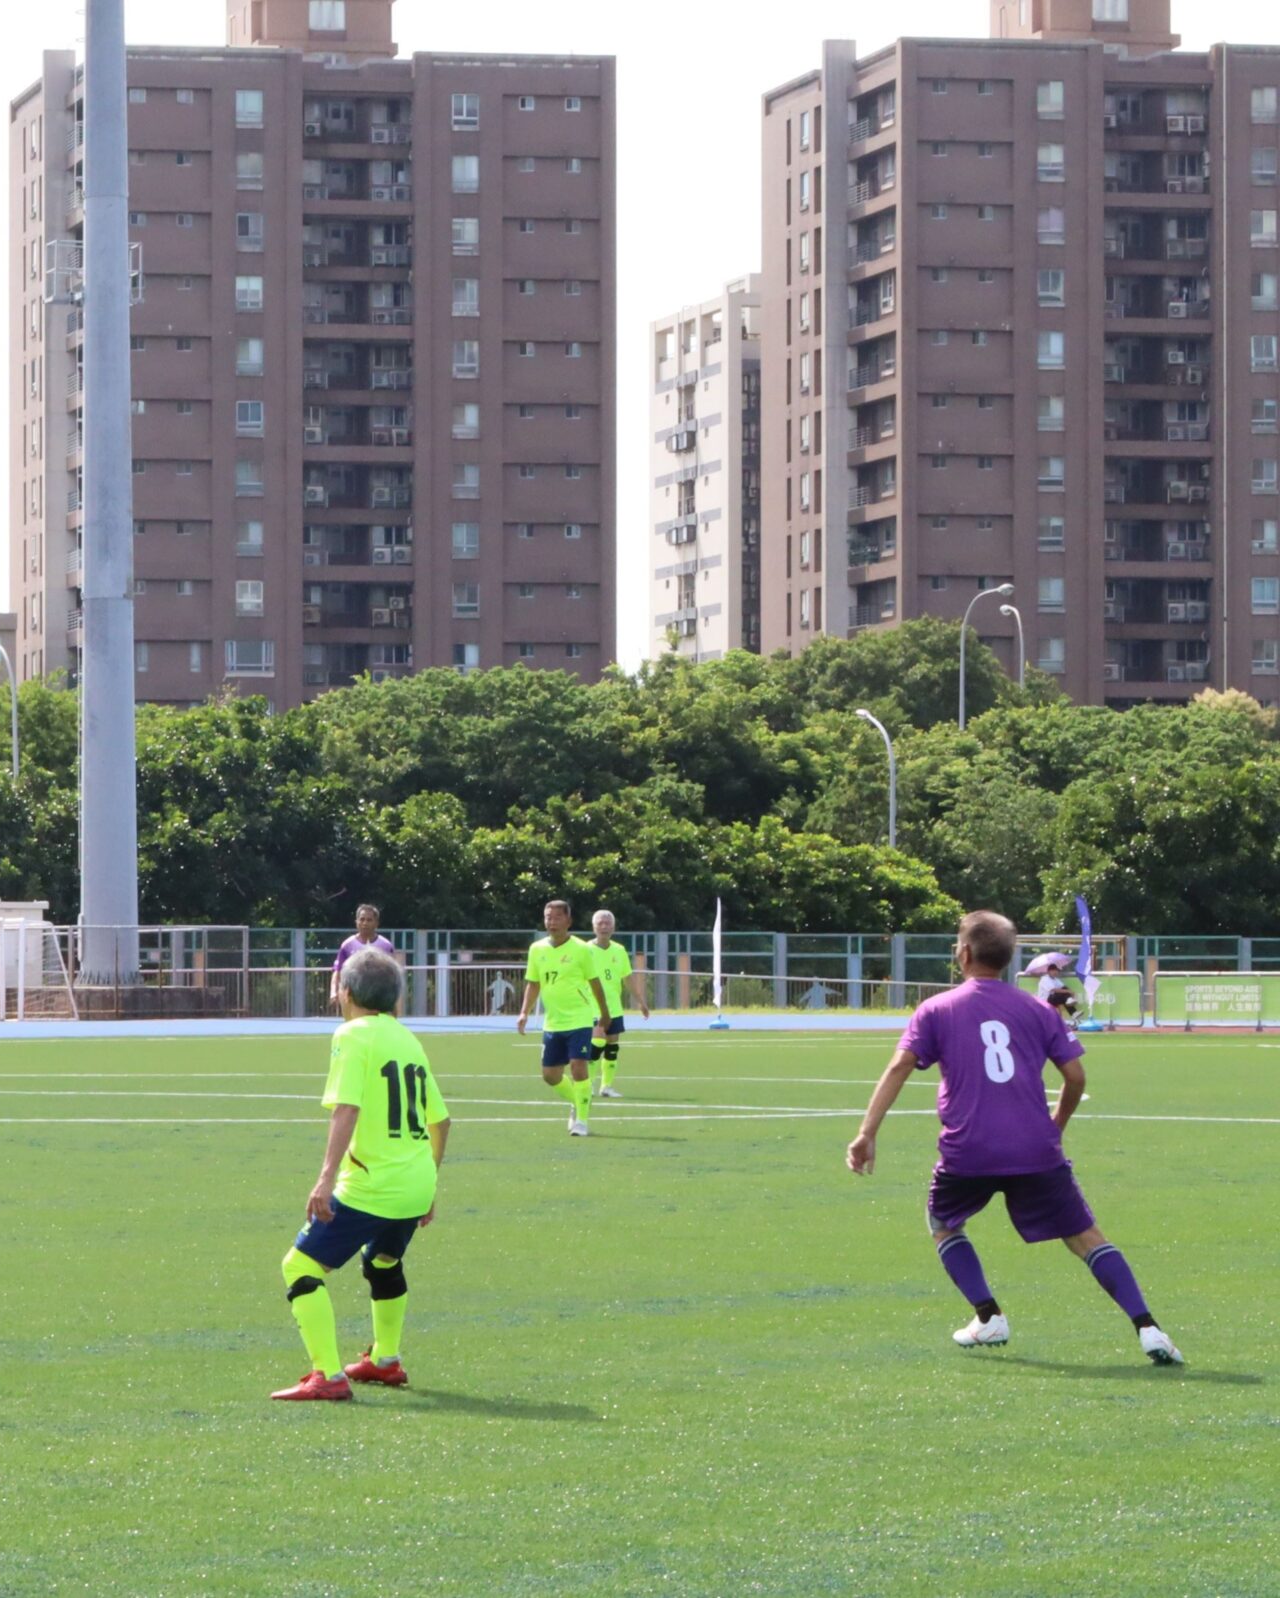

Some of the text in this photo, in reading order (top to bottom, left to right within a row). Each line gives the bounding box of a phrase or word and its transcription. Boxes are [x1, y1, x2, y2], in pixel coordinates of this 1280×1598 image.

[544, 971, 558, 985] 17
[604, 968, 612, 981] 8
[980, 1020, 1015, 1083] 8
[380, 1060, 429, 1140] 10
